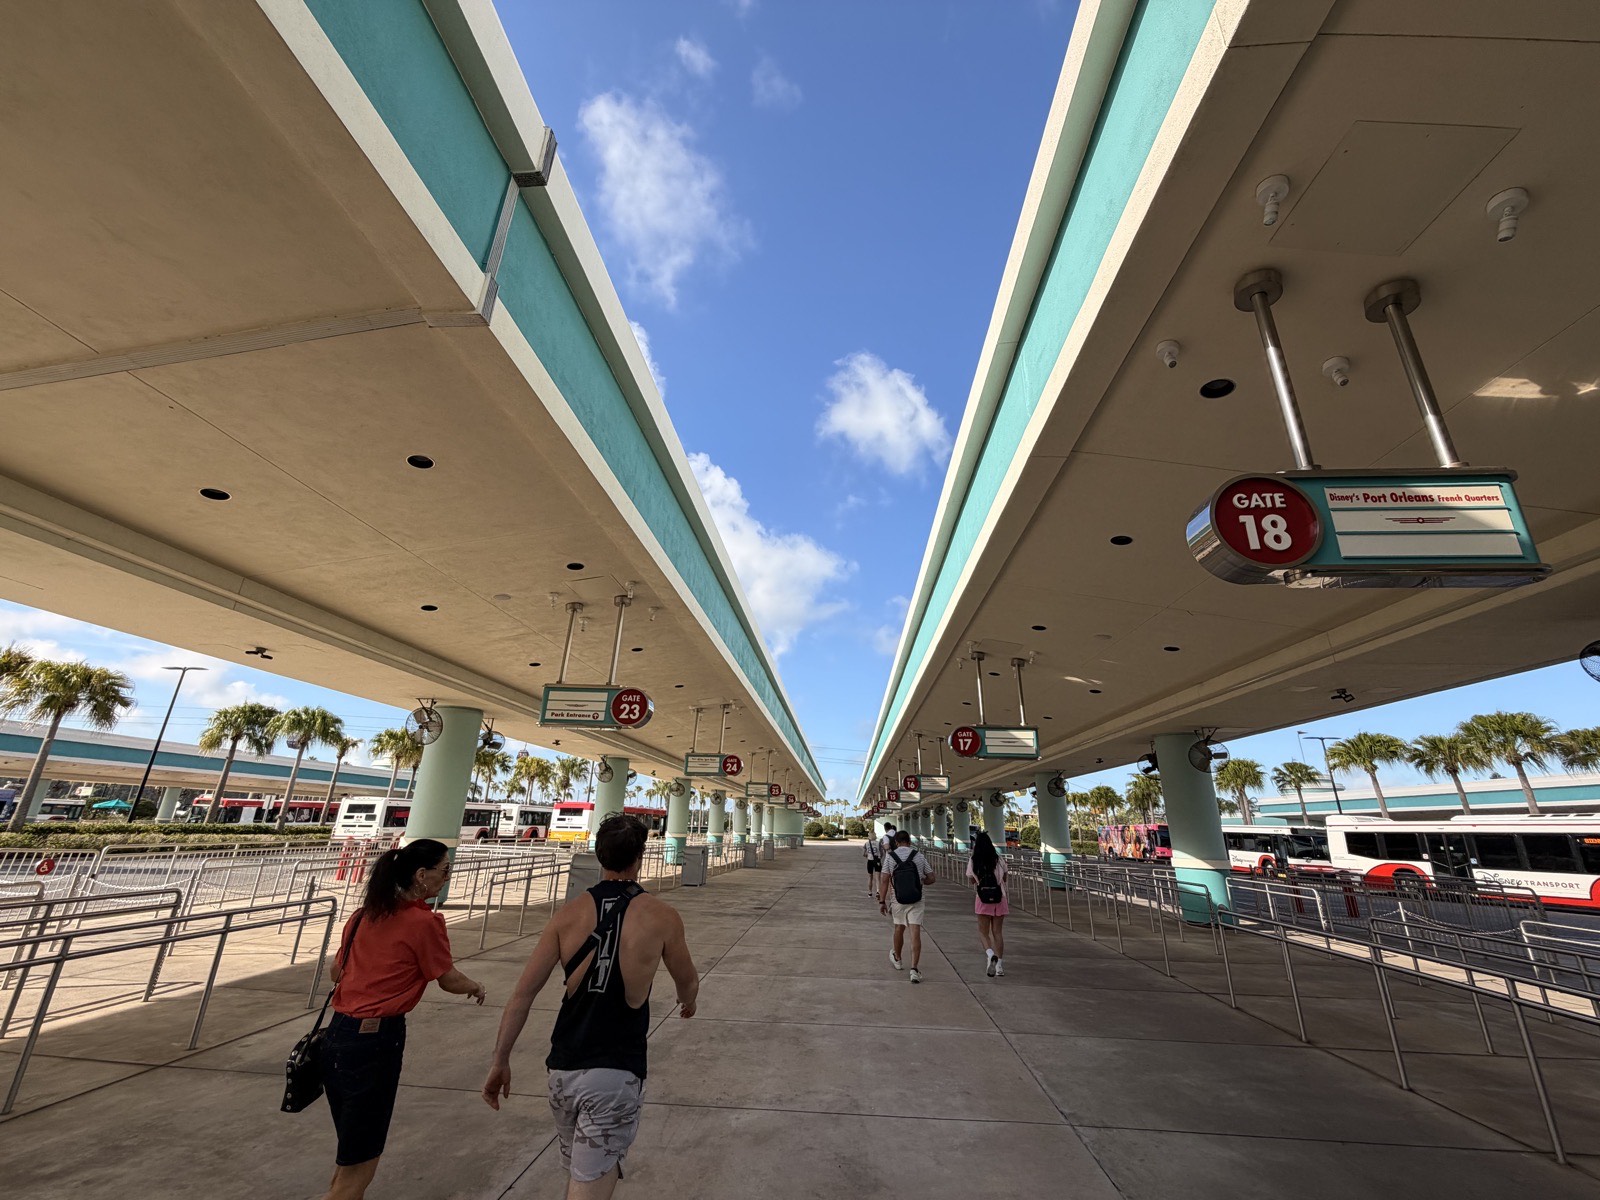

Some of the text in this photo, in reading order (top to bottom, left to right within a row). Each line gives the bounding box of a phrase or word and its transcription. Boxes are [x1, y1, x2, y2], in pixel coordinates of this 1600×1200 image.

[1232, 492, 1287, 509] GATE
[1329, 491, 1500, 503] Disney's Port Orleans French Quarters
[1238, 513, 1293, 551] 18
[618, 704, 640, 720] 23
[958, 738, 973, 751] 17
[726, 763, 737, 772] 24
[1524, 880, 1581, 889] TRANSPORT
